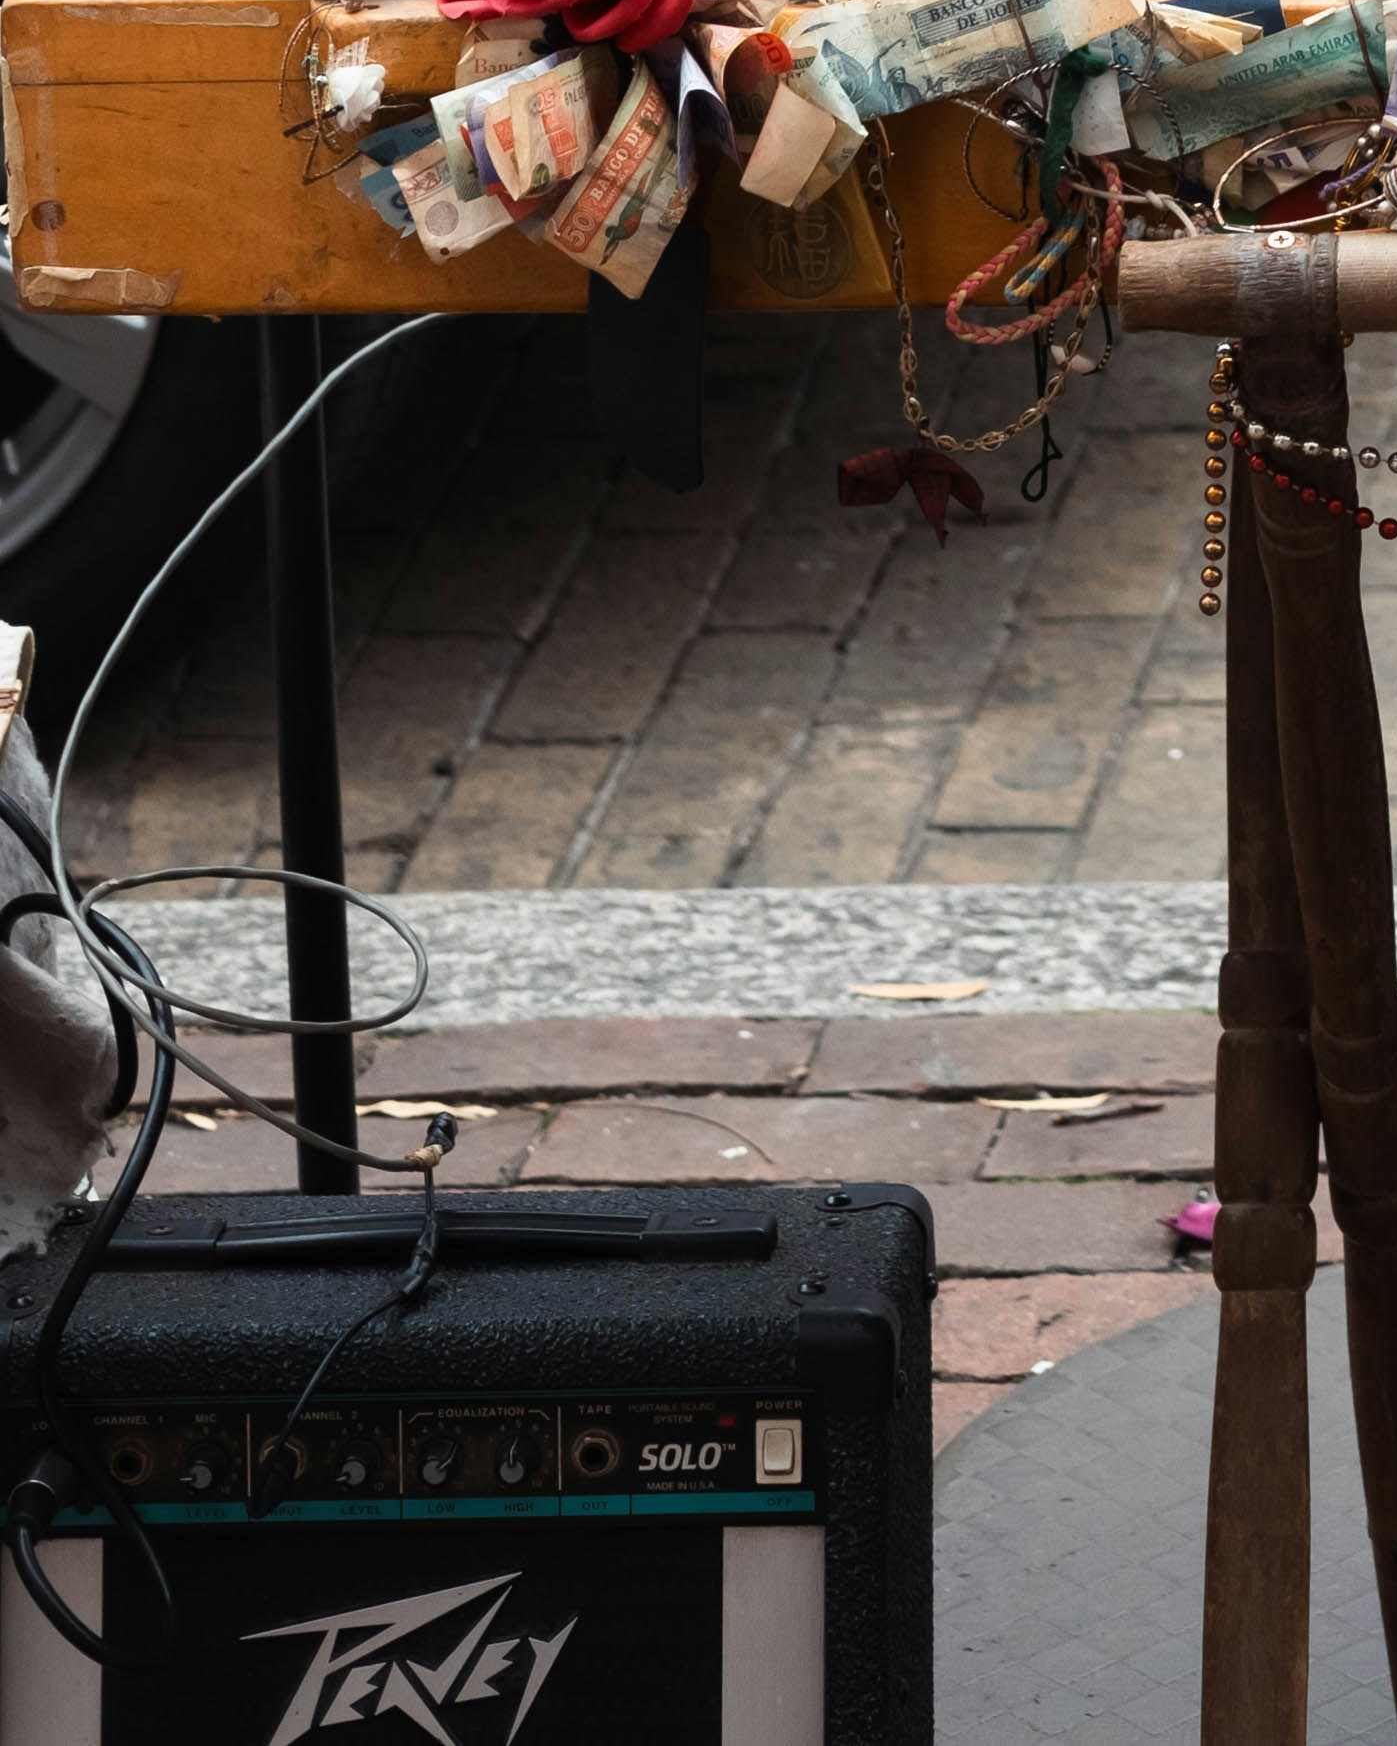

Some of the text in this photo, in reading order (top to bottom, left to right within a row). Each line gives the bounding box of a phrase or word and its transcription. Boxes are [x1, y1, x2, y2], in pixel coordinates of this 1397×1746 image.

[1217, 62, 1269, 87] UNITED
[1271, 50, 1306, 71] ARAB
[1309, 28, 1373, 57] EMIRATS
[565, 209, 597, 248] 50
[589, 147, 629, 202] BANCO
[578, 1404, 613, 1416] TAPE
[755, 1399, 803, 1411] POWER
[195, 1413, 217, 1423] MIC
[437, 1406, 526, 1418] EQUALIZATION
[94, 1415, 150, 1426] CHANNEL
[653, 1414, 693, 1425] SYSTEM
[646, 1480, 675, 1492] MADE
[504, 1501, 534, 1513] HIGH
[581, 1500, 609, 1511] OUT
[767, 1495, 793, 1507] OFF
[426, 1502, 456, 1514] LOW
